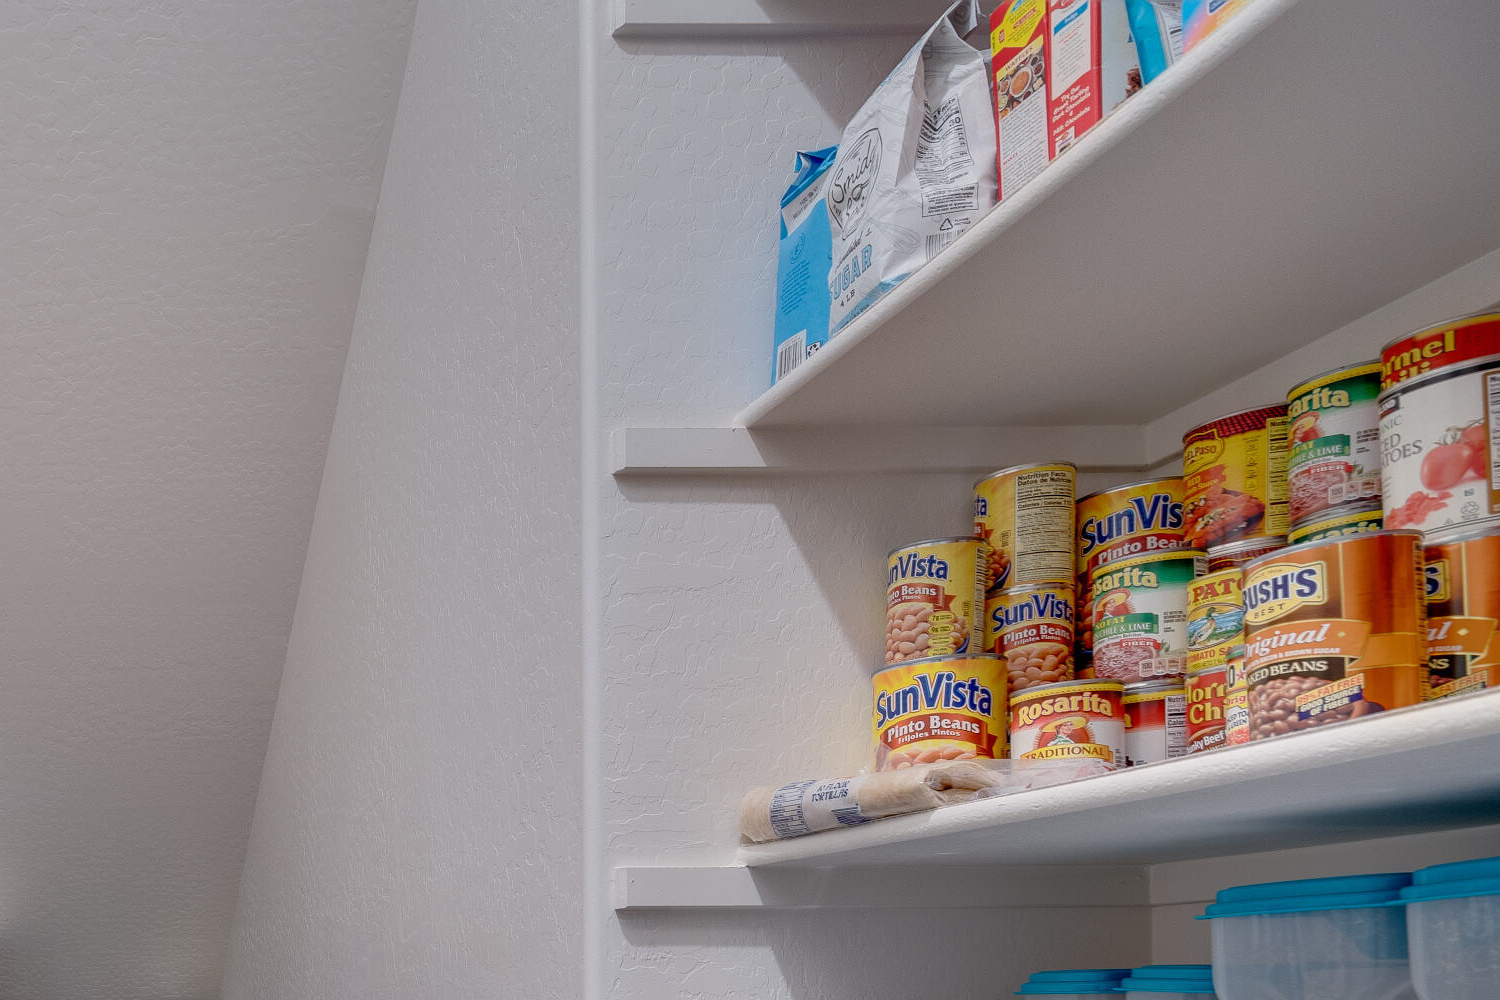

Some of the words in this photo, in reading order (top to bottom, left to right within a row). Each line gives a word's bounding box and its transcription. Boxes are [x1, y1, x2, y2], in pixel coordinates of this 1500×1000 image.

[1382, 329, 1456, 378] rmel
[1288, 387, 1350, 420] arita
[1317, 445, 1341, 455] LIME
[1310, 465, 1345, 474] FIBER
[1081, 494, 1184, 556] SunVis
[1097, 541, 1142, 565] Pinto
[887, 551, 949, 588] unVista
[1093, 567, 1158, 594] sarita
[901, 585, 937, 596] Beans
[1253, 603, 1285, 619] BEST
[1003, 627, 1037, 646] Pinto
[1039, 624, 1071, 640] Beans
[1128, 622, 1151, 632] LIME
[1269, 660, 1329, 677] BEANS
[1317, 683, 1336, 698] FAT
[1337, 674, 1364, 690] FREE
[875, 671, 994, 729] SunVista
[1018, 690, 1112, 727] Rosarita
[1300, 696, 1324, 712] GOOD
[1324, 685, 1361, 704] SOURCE
[1310, 705, 1322, 716] OF
[1323, 698, 1350, 712] FIBER
[887, 718, 926, 743] Pinto
[929, 715, 980, 735] Beans
[898, 730, 930, 744] Frijoles
[931, 727, 961, 738] Pintos
[1204, 731, 1225, 744] Beef
[1025, 744, 1106, 760] TRADITIONAL
